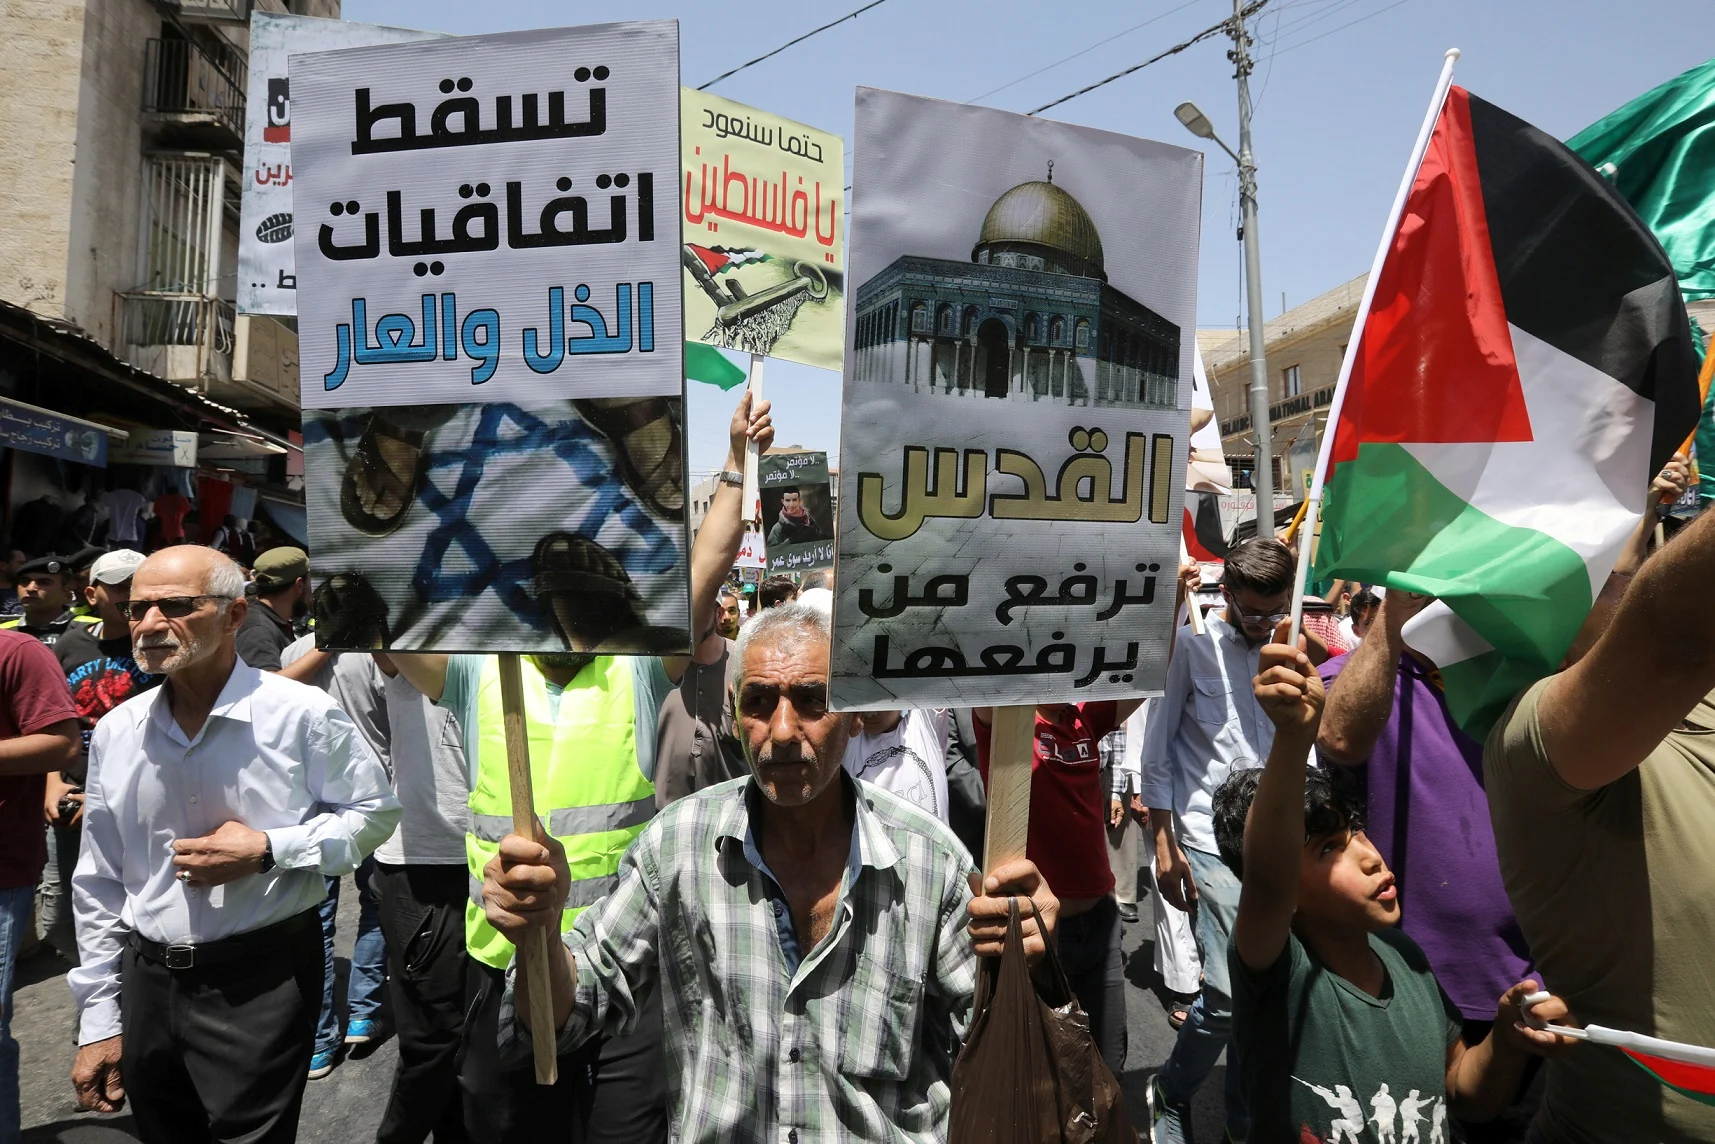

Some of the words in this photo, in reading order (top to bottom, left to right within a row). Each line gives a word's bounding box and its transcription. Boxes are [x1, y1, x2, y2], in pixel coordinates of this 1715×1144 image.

[351, 66, 609, 155] تسقط
[702, 108, 772, 147] سنعود
[778, 126, 824, 164] حتما
[685, 146, 808, 239] فلسطين
[318, 173, 654, 276] اتفاقيات
[815, 181, 836, 263] يا
[324, 293, 500, 392] والعار
[522, 282, 655, 374] الذل
[764, 470, 788, 484] مؤتمر
[785, 456, 809, 470] مؤتمر
[857, 425, 1174, 541] القدس
[770, 556, 785, 572] عمر
[802, 544, 817, 567] أريد
[818, 546, 825, 561] لا
[858, 563, 970, 619] من
[995, 562, 1160, 627] ترفع
[872, 630, 1140, 688] يرفعها
